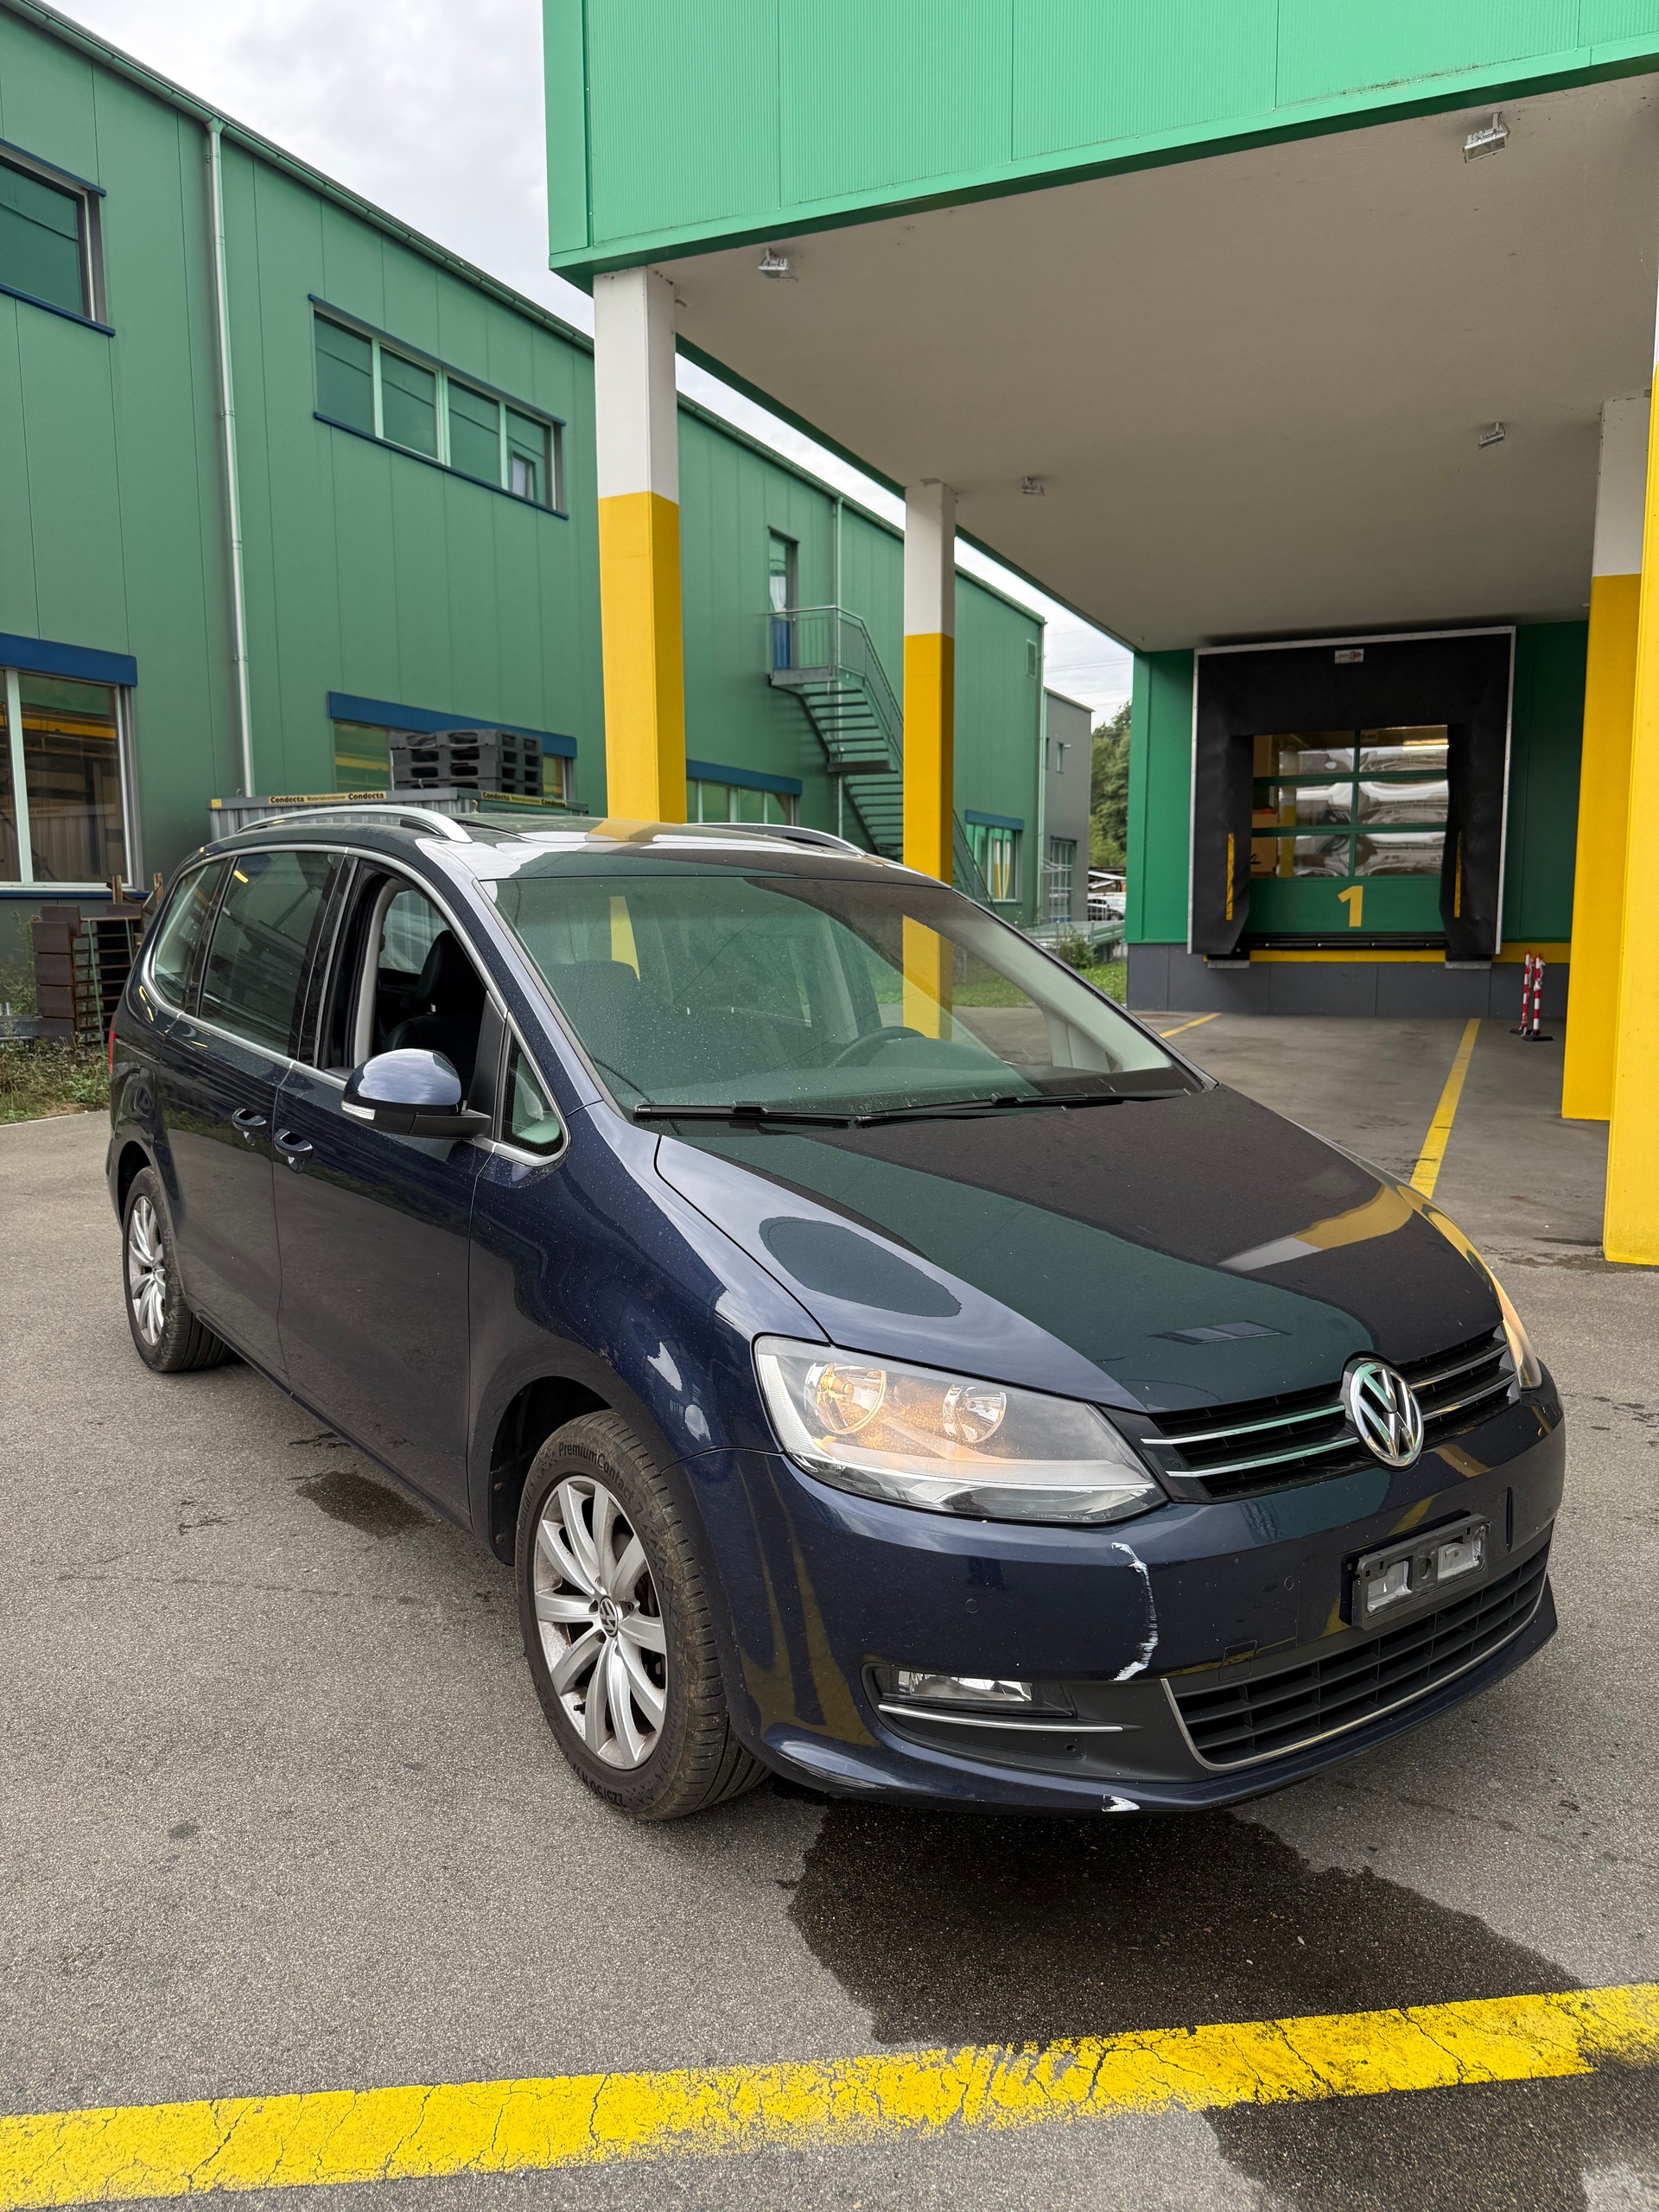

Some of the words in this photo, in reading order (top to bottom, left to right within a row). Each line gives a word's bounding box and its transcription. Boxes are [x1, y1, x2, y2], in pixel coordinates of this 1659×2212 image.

[483, 792, 511, 801] Condecta
[541, 798, 566, 807] Condecta
[1338, 886, 1363, 927] 1
[558, 1442, 633, 1504] PremiumContact
